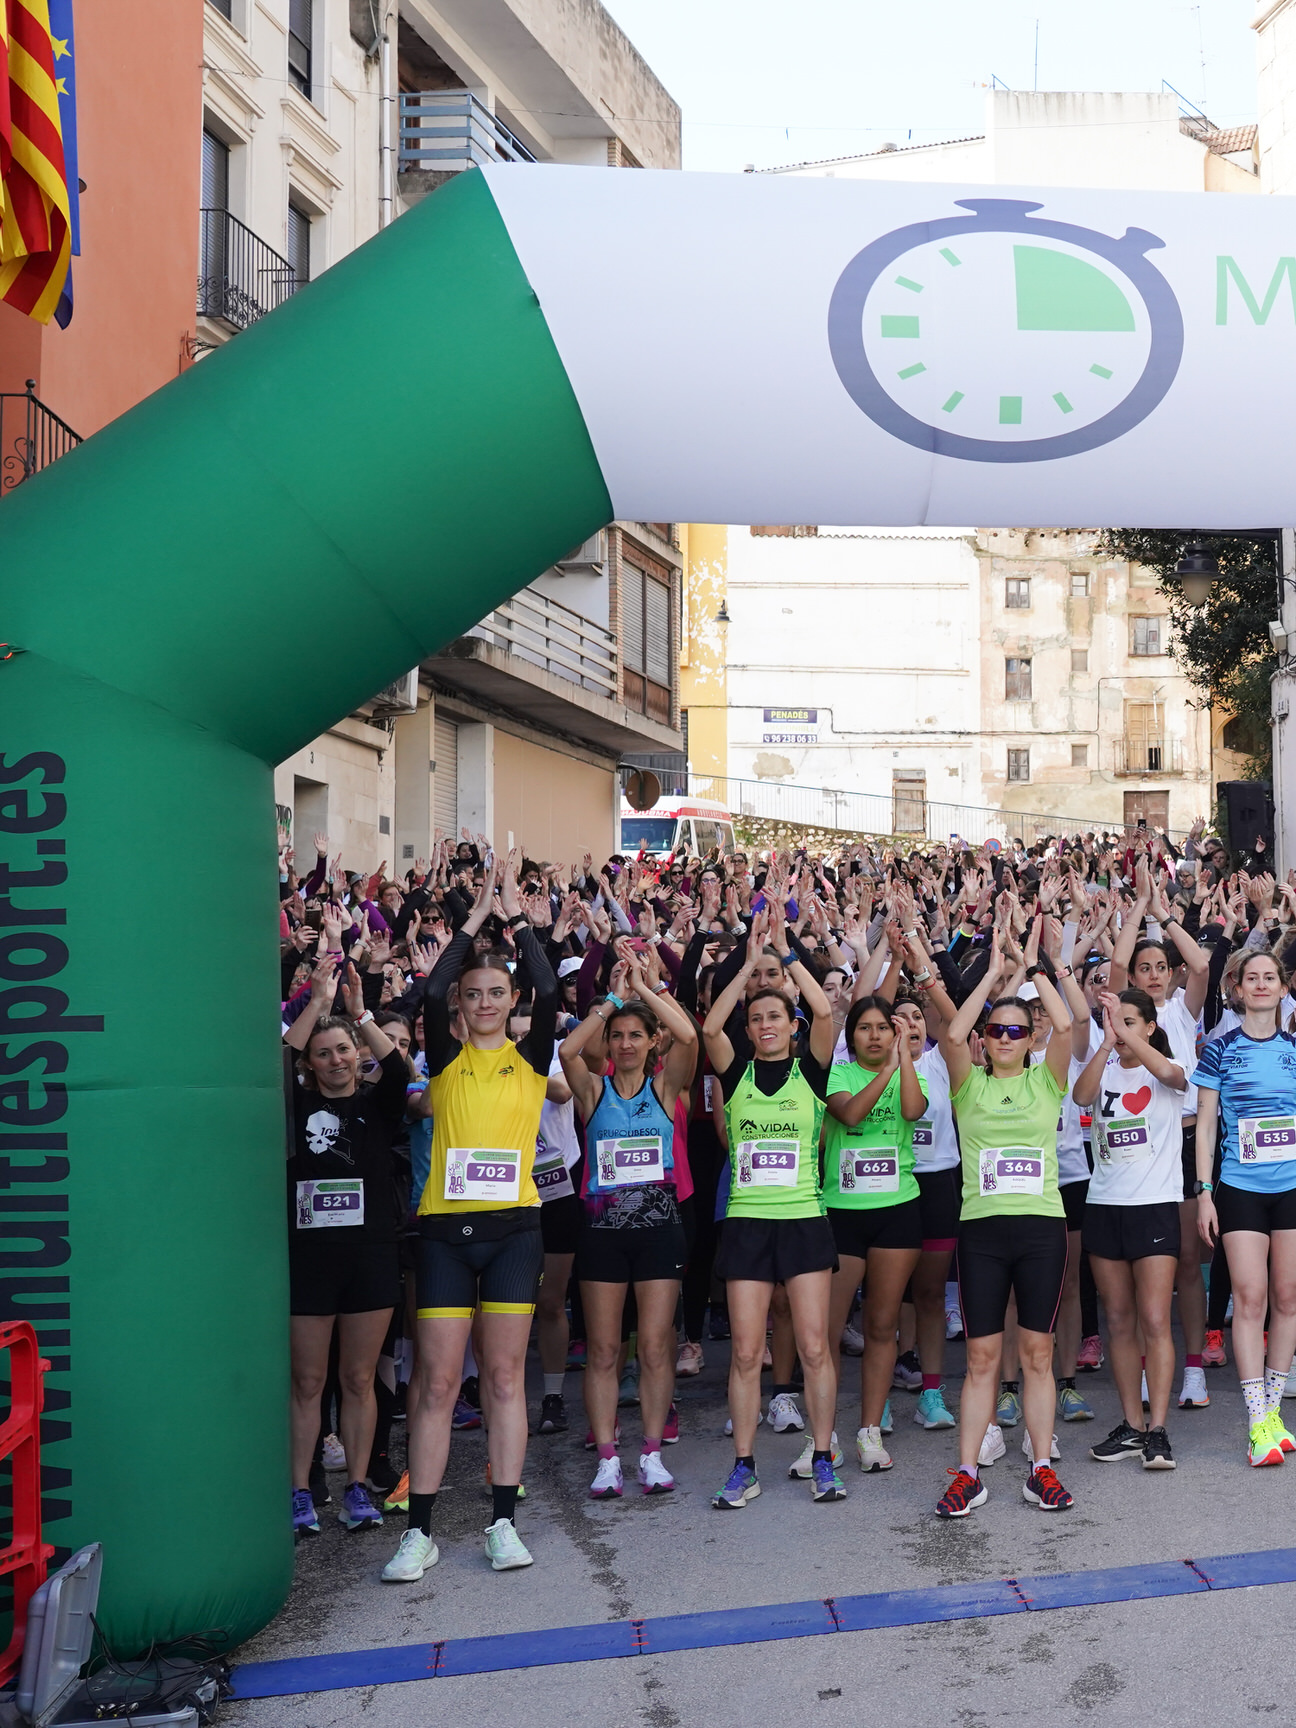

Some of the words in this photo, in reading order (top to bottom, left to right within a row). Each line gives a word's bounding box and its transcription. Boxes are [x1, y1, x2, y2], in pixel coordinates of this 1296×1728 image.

[771, 735, 781, 743] 96
[781, 735, 796, 743] 238
[797, 735, 807, 743] 06
[807, 735, 817, 743] 33
[1101, 1090, 1120, 1118] I
[760, 1123, 799, 1132] VIDAL
[741, 1132, 799, 1141] CONSTRUCCIONES
[1114, 1131, 1139, 1144] 550
[1263, 1132, 1289, 1144] 535
[623, 1152, 651, 1164] 758
[758, 1155, 788, 1166] 834
[476, 1166, 506, 1178] 702
[862, 1163, 889, 1173] 662
[1005, 1162, 1034, 1173] 364
[538, 1171, 560, 1185] 670
[448, 1183, 465, 1194] NES
[323, 1196, 350, 1207] 521
